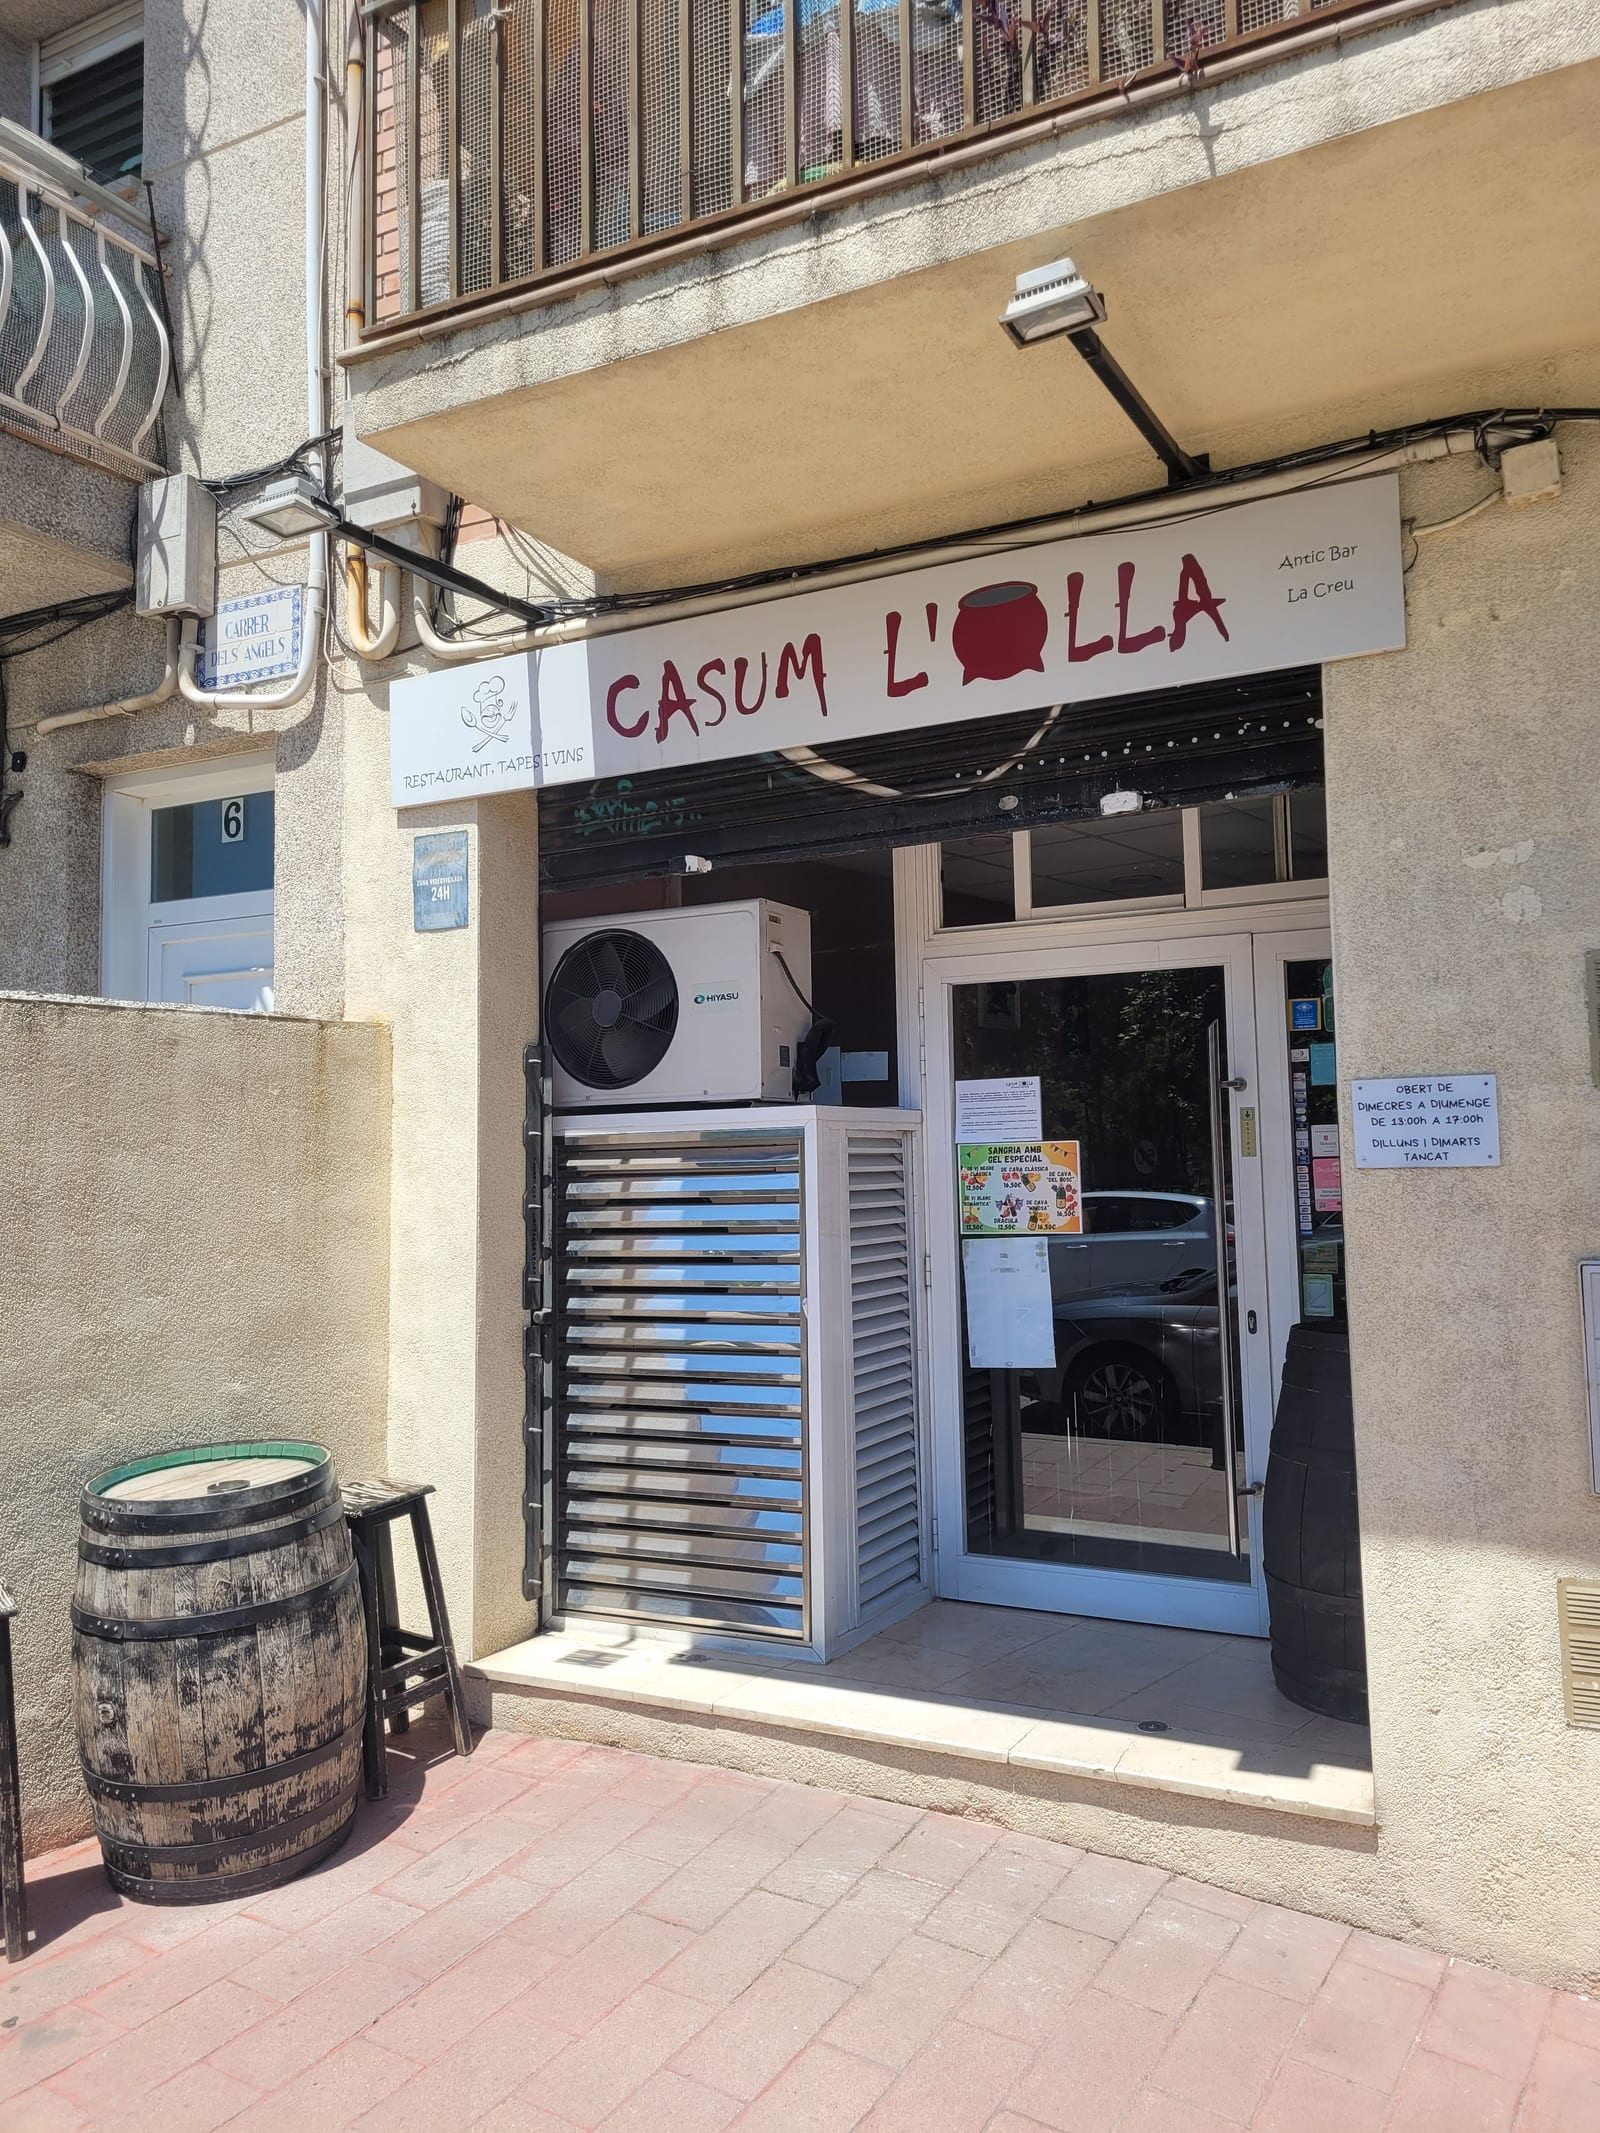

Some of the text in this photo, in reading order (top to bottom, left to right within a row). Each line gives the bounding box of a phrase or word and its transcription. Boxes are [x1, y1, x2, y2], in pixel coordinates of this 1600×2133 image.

[1278, 545, 1358, 570] Antic Bar
[1288, 579, 1354, 603] La Creu
[225, 614, 269, 640] CARRER
[211, 648, 239, 667] DELS
[606, 632, 829, 743] CASUM
[497, 754, 541, 774] TAPES
[543, 753, 548, 767] I
[551, 747, 584, 766] VINS
[223, 801, 242, 839] 6
[431, 885, 450, 902] 24H
[706, 991, 739, 1002] HIYASU
[1396, 1082, 1453, 1095] OBERT DE
[1357, 1097, 1491, 1112] DIMECRES A DIUMENGE
[1371, 1114, 1484, 1127] DE 13:00h A 17:00h
[988, 1145, 1042, 1155] SANGRIA AMB
[1372, 1136, 1481, 1148] DILLUNS I DIMARTS
[988, 1154, 1043, 1164] GEL ESPECIAL
[1403, 1152, 1449, 1162] TANCAT
